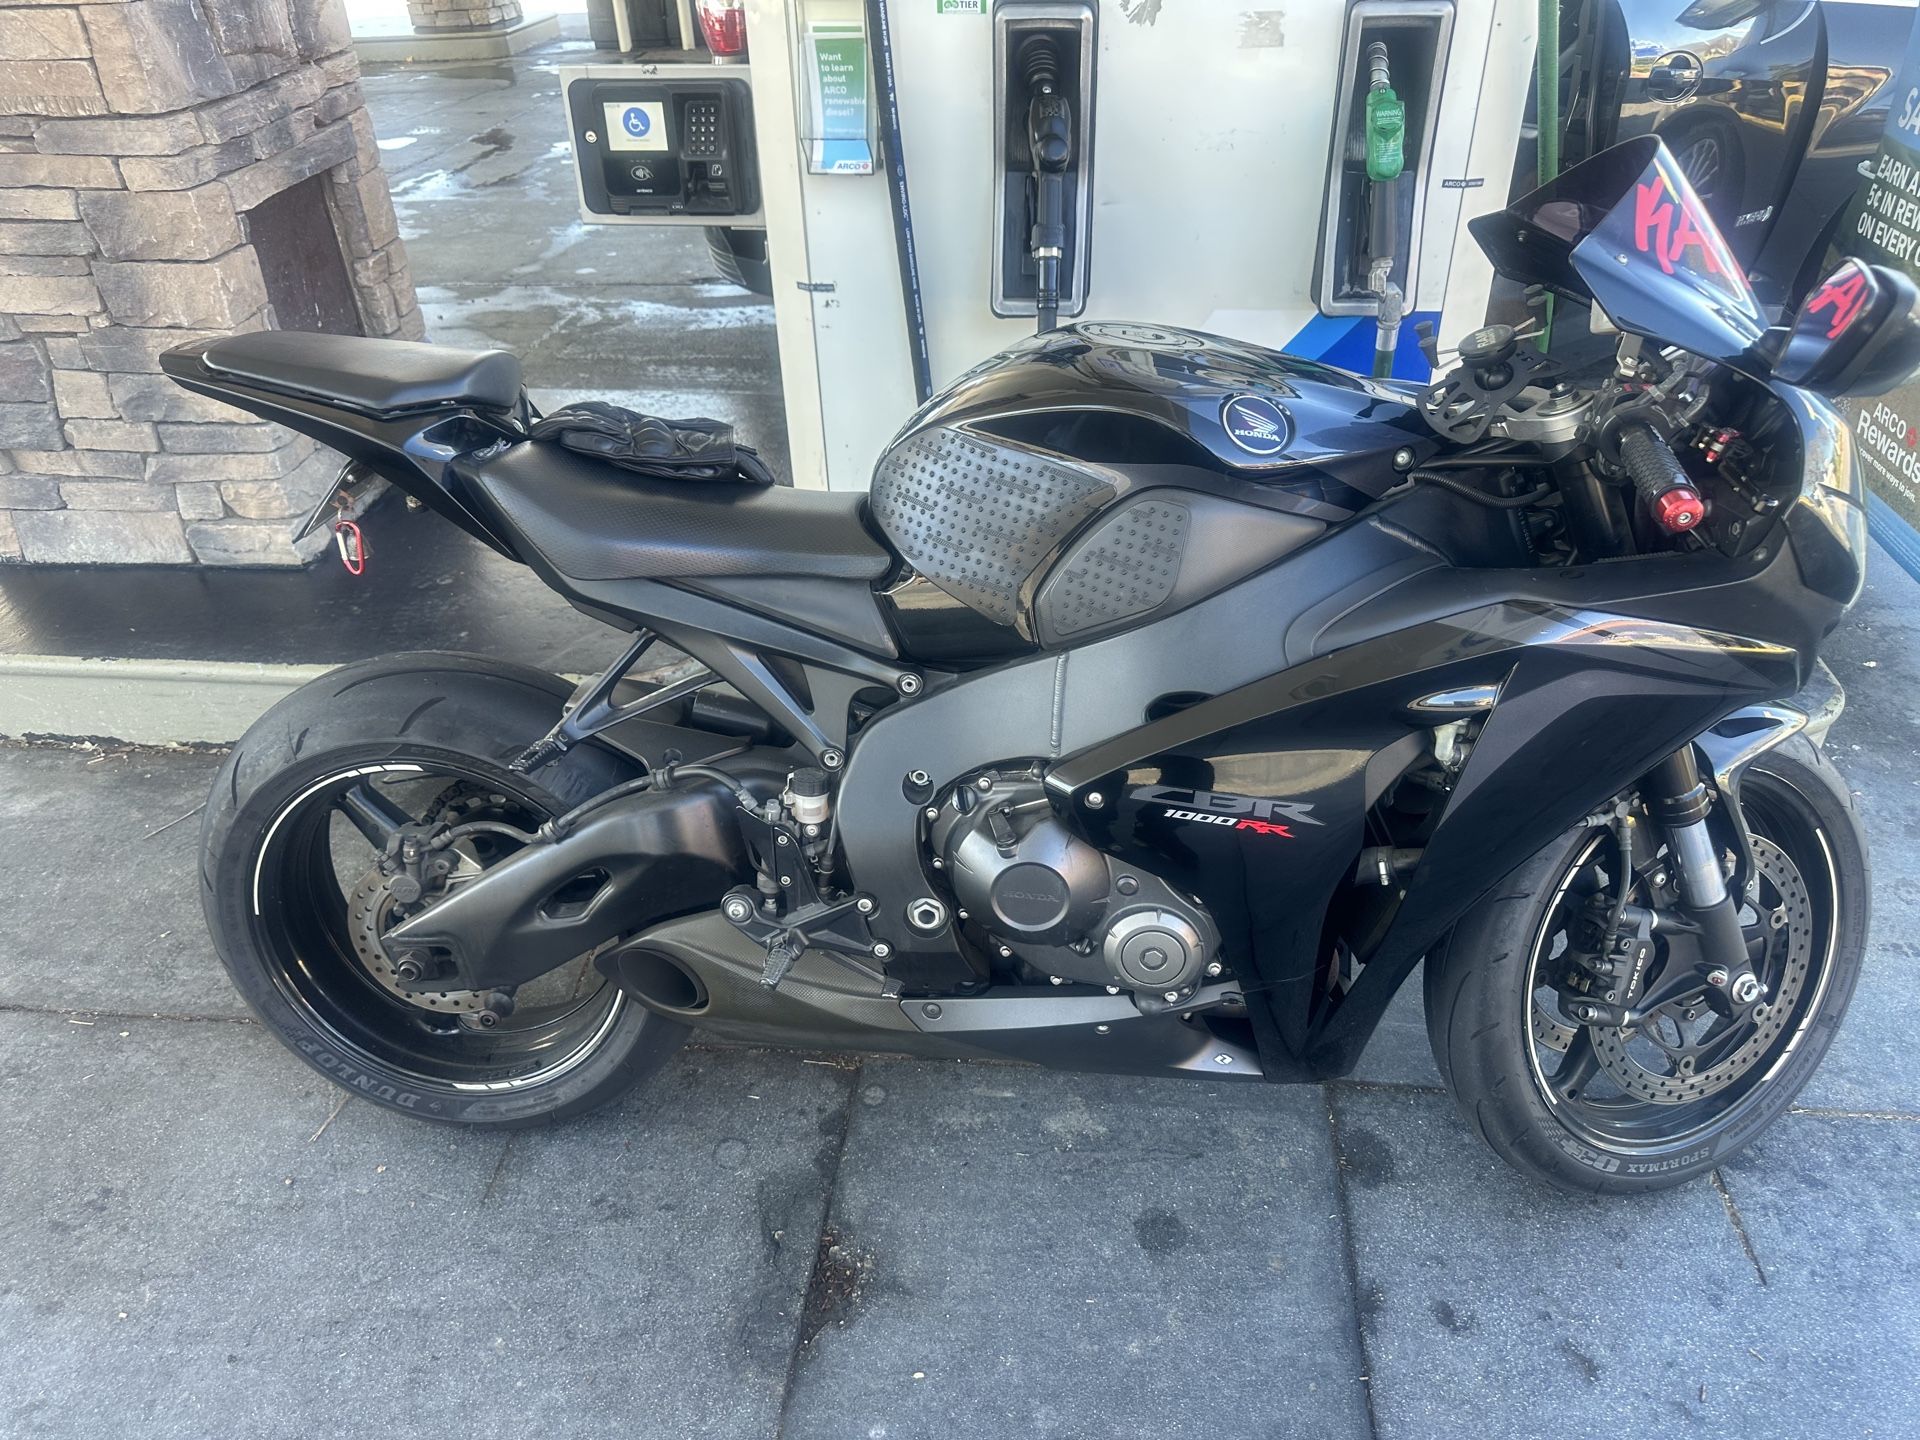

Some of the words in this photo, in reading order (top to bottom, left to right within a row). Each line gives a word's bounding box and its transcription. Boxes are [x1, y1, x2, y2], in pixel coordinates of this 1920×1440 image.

[960, 0, 978, 9] TIER
[819, 52, 842, 61] Want
[821, 63, 830, 72] to
[831, 63, 854, 72] learn
[822, 74, 847, 83] about
[824, 86, 847, 95] ARCO
[1376, 108, 1402, 117] WARNING
[1877, 154, 1911, 190] EARN
[1866, 183, 1882, 210] 5¢
[1879, 190, 1897, 217] IN
[1857, 211, 1876, 239] ON
[1873, 221, 1917, 261] EVERY
[1234, 429, 1281, 442] HONDA
[1873, 402, 1907, 439] ARCO
[1857, 409, 1920, 484] Rewards
[1859, 446, 1874, 463] cover
[1873, 460, 1886, 475] more
[1886, 471, 1899, 487] ways
[1899, 482, 1905, 492] to
[1903, 486, 1916, 503] join.
[1129, 785, 1326, 826] CBR
[1001, 889, 1061, 903] HONDA
[1627, 948, 1646, 999] TOKICO
[296, 1039, 422, 1109] DUNLOP
[1626, 1146, 1710, 1174] SPORTMAX
